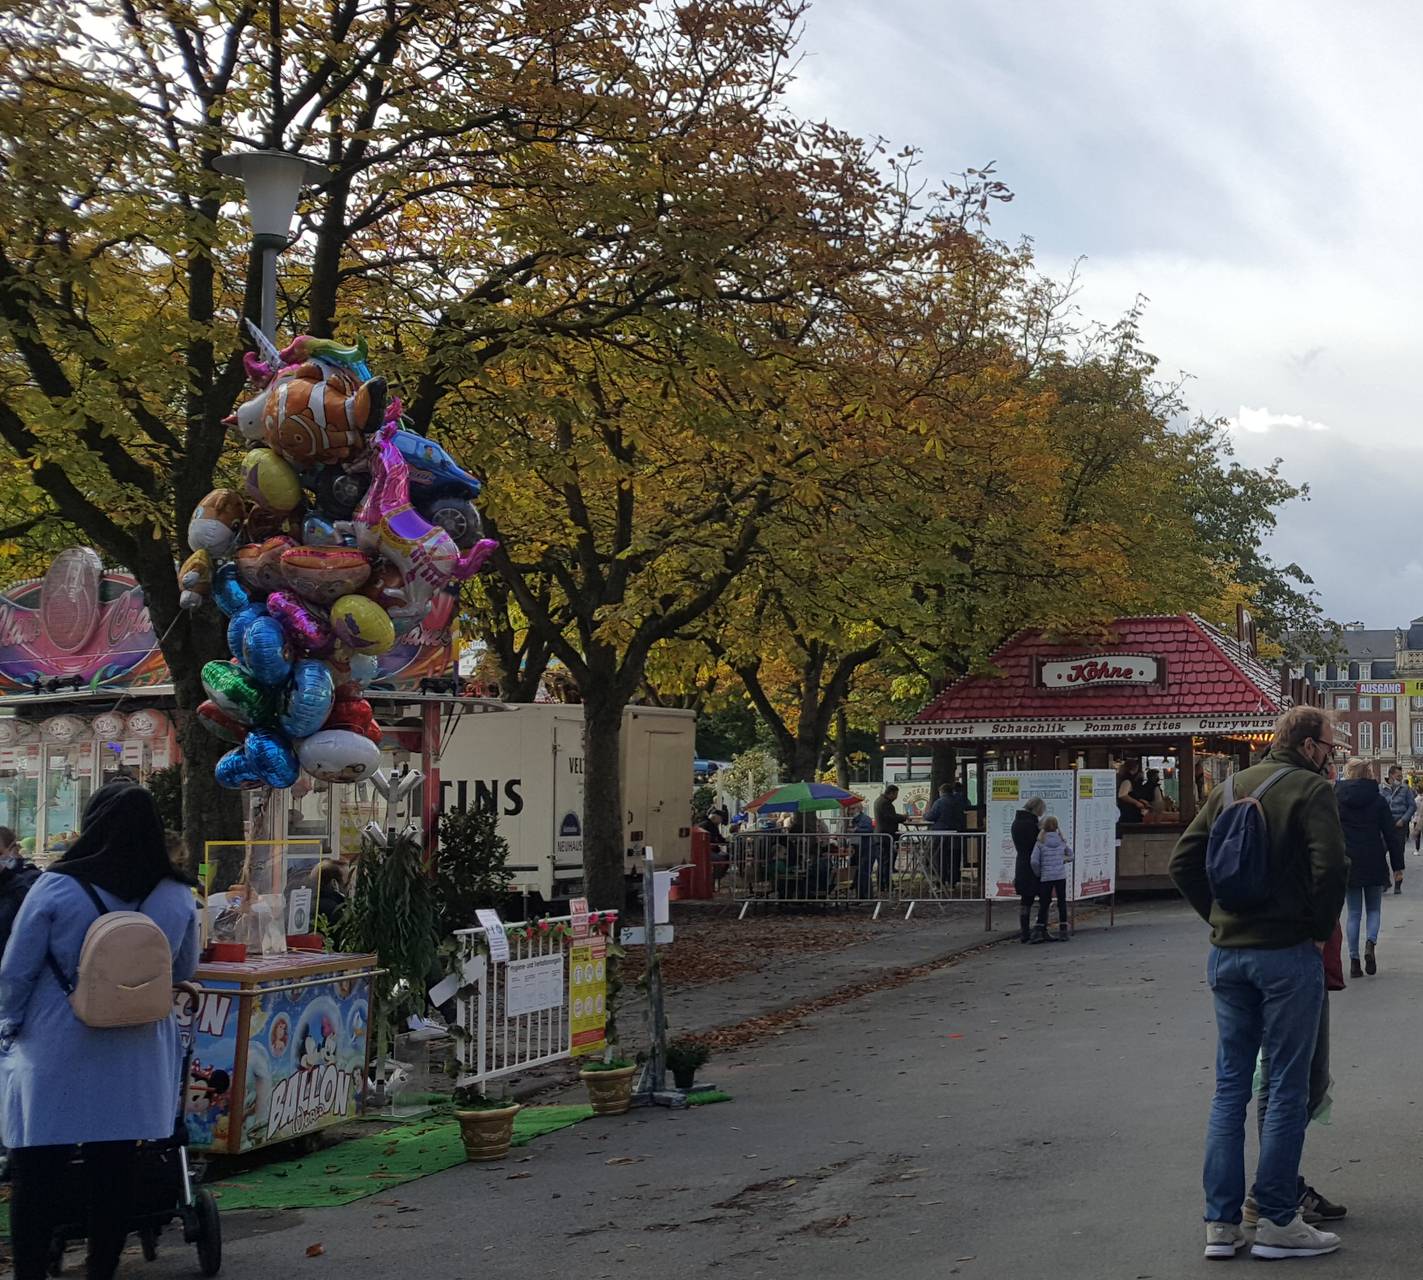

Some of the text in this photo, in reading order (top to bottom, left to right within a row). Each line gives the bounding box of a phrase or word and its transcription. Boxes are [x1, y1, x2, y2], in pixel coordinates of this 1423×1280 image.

[1067, 661, 1134, 682] Köhne
[1359, 682, 1402, 694] AUSGANG
[902, 725, 974, 736] Bratwurst
[991, 723, 1066, 734] Schaschlik
[1084, 722, 1137, 732] Pommes
[1143, 720, 1181, 731] frites
[267, 1064, 353, 1141] BALLON
